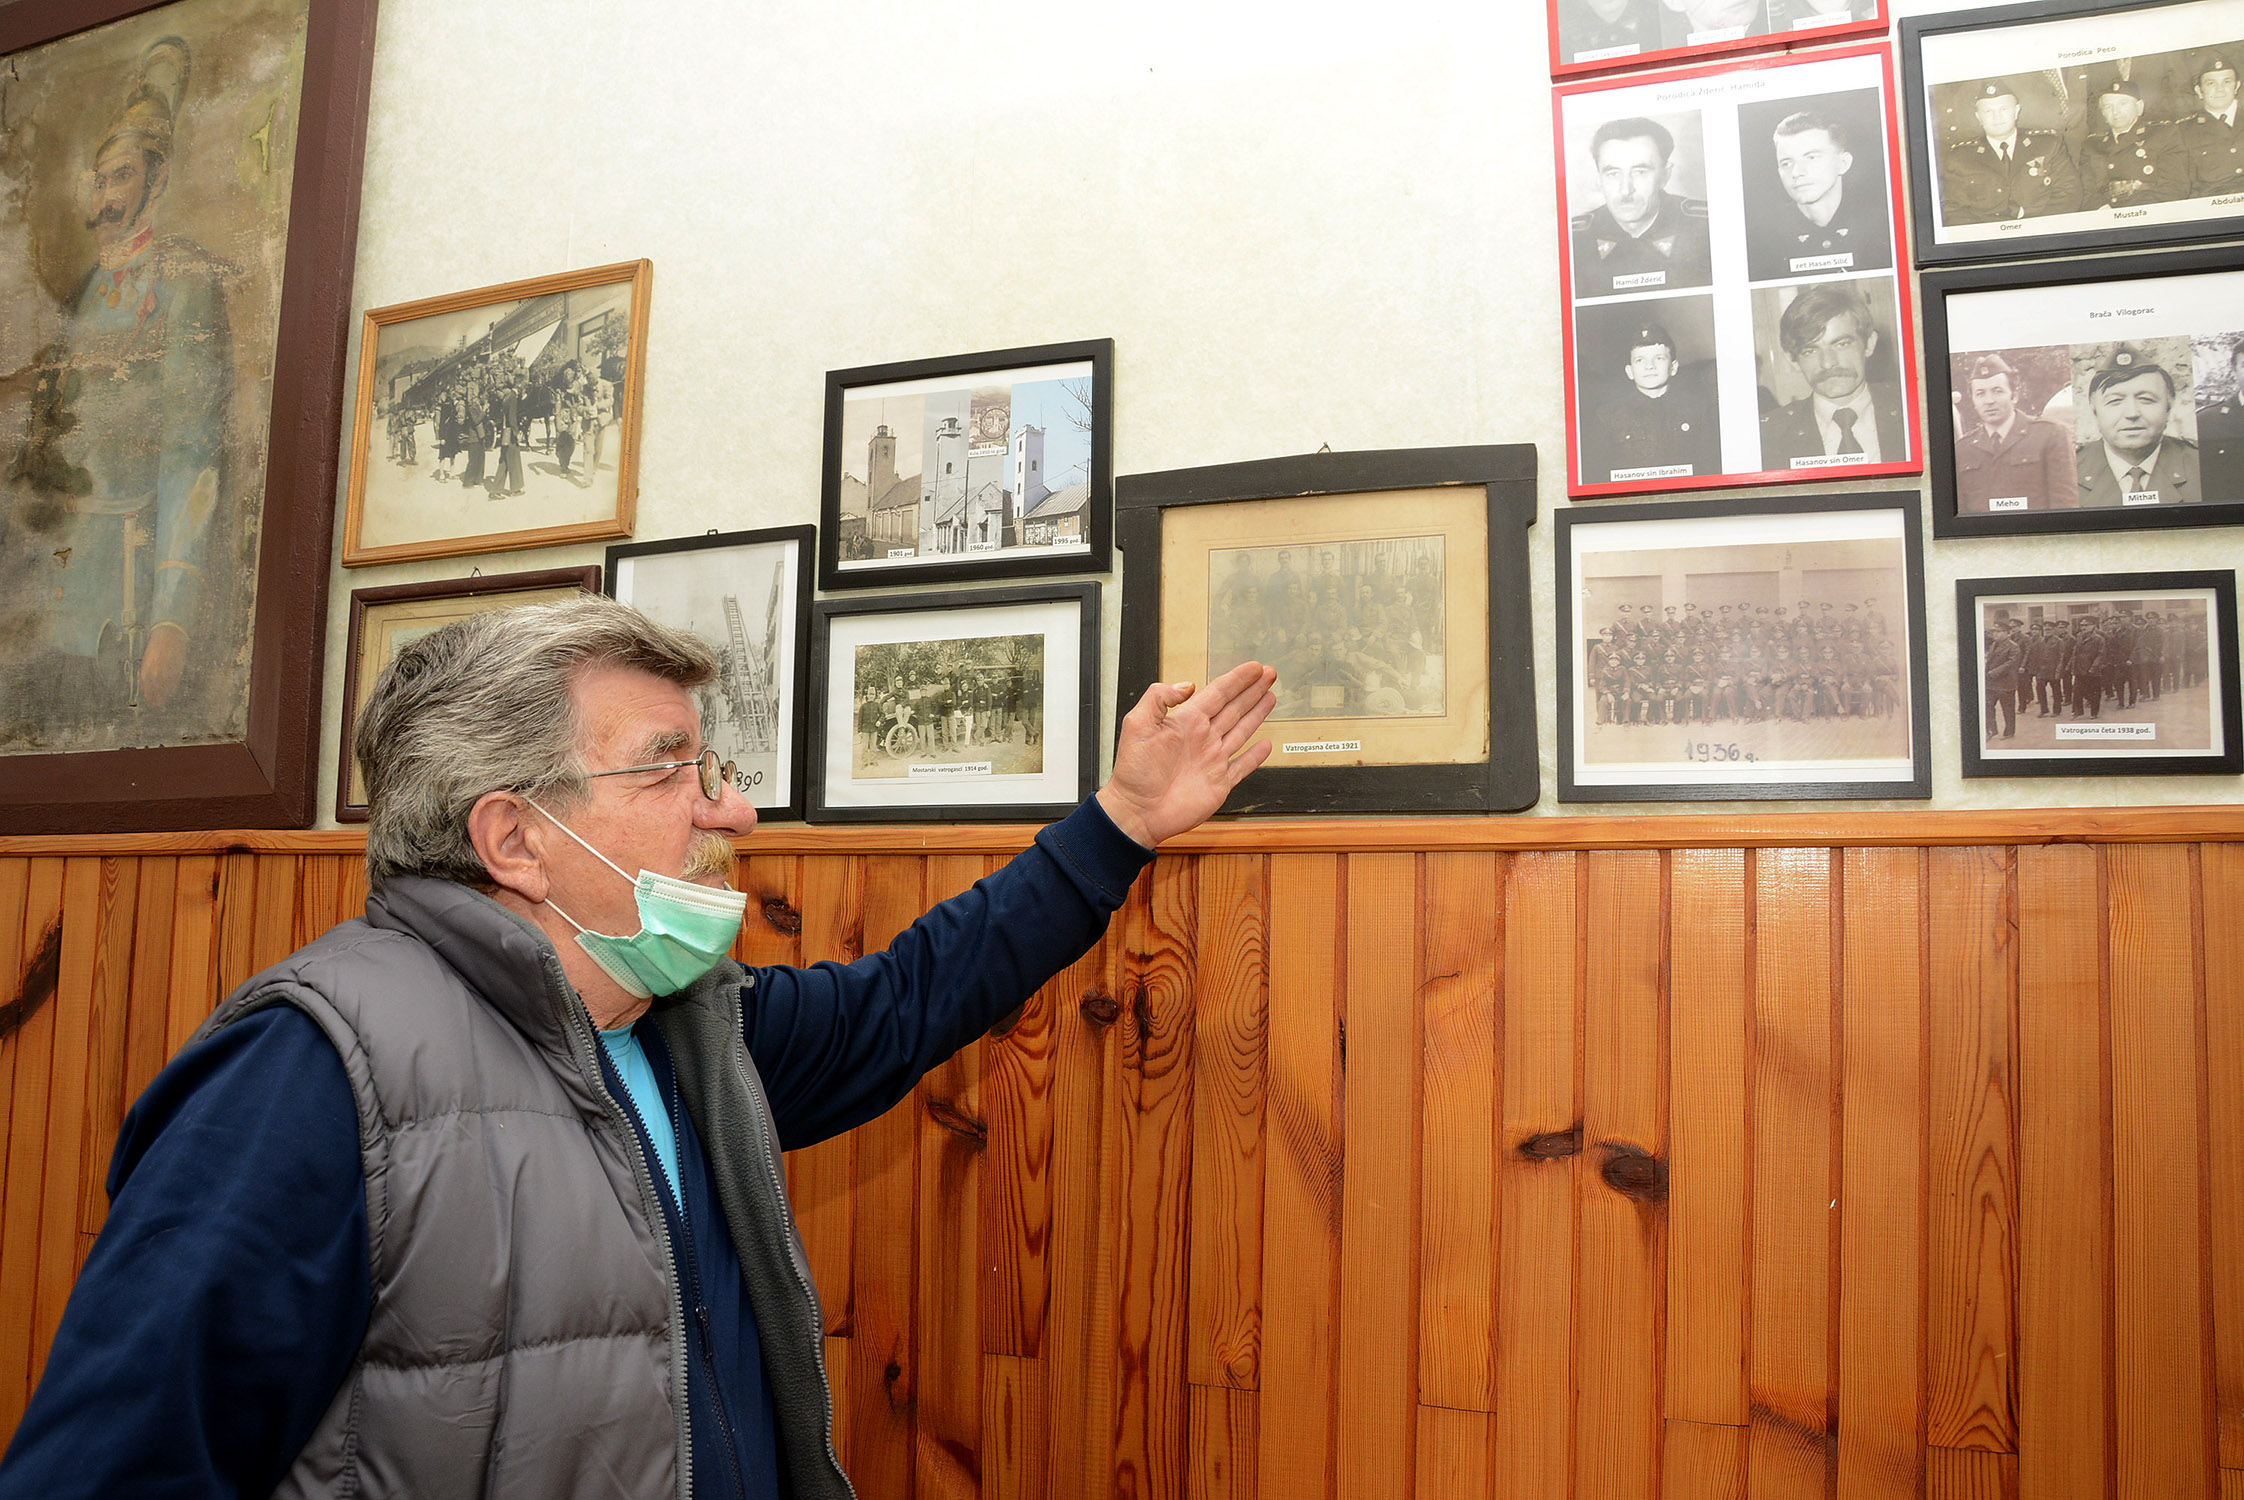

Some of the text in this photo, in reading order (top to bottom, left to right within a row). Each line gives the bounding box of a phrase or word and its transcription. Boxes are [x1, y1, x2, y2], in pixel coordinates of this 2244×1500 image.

[2057, 49, 2093, 59] Porodica
[2113, 209, 2148, 219] Mustafa
[1615, 278, 1639, 286] Hamid
[1796, 455, 1864, 467] Hasanov sin Omer
[1614, 467, 1688, 479] Hasanov sin Ibrahim
[2128, 494, 2157, 502] Mithat
[1996, 500, 2020, 508] Meho
[2060, 727, 2100, 735] Vatrogasna
[2136, 727, 2151, 735] god.
[1285, 744, 1324, 752] Vatrogasna
[1341, 742, 1359, 750] 1921
[1684, 738, 1741, 763] 1936
[911, 766, 937, 774] Mostarski
[938, 766, 963, 774] vatrogasci
[964, 765, 977, 773] 1914
